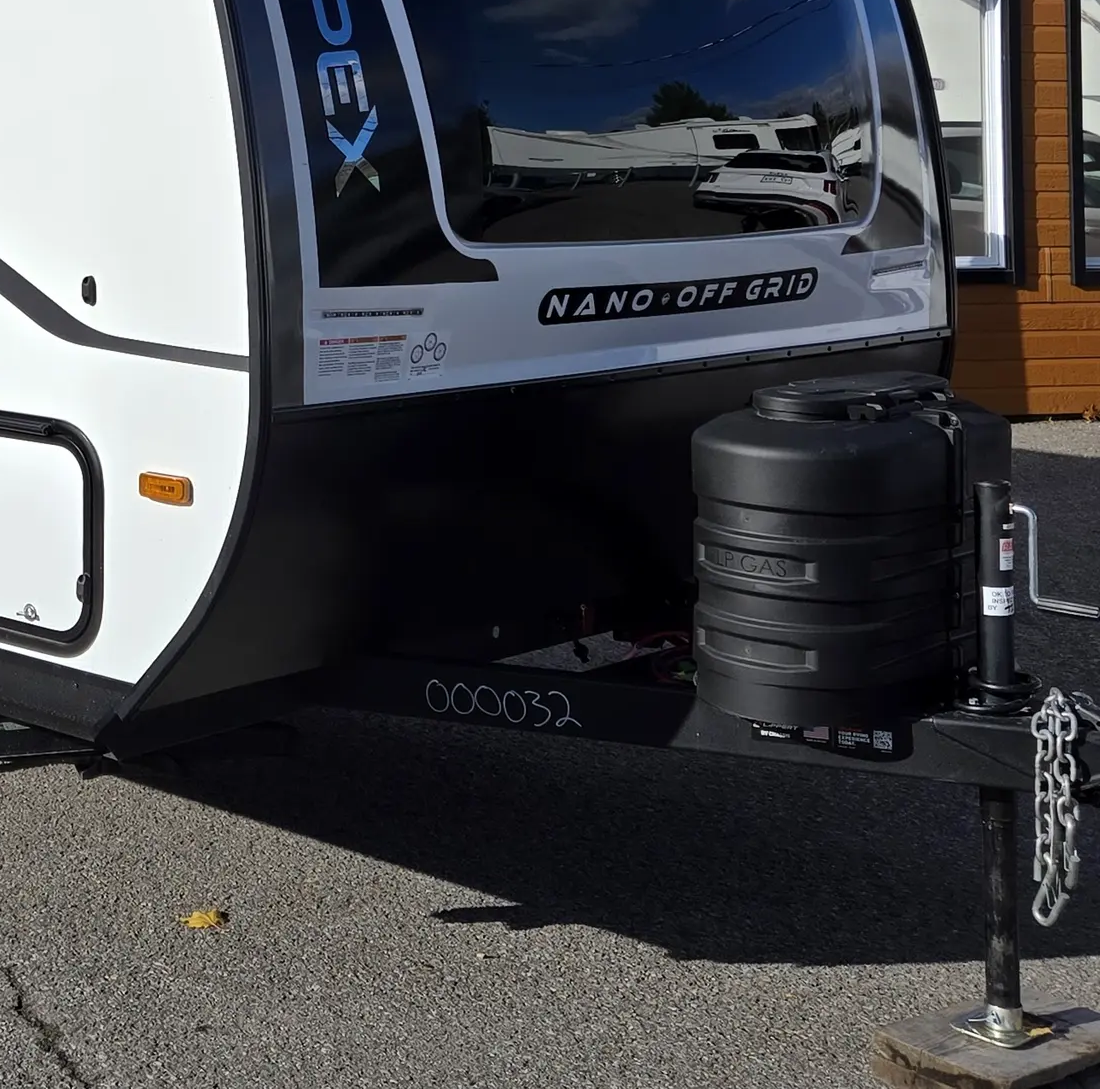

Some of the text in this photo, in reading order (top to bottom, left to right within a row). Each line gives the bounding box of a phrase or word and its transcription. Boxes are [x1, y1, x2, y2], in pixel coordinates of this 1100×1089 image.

[745, 272, 814, 300] GRID
[716, 549, 787, 578] LP GAS
[426, 679, 582, 727] 000032
